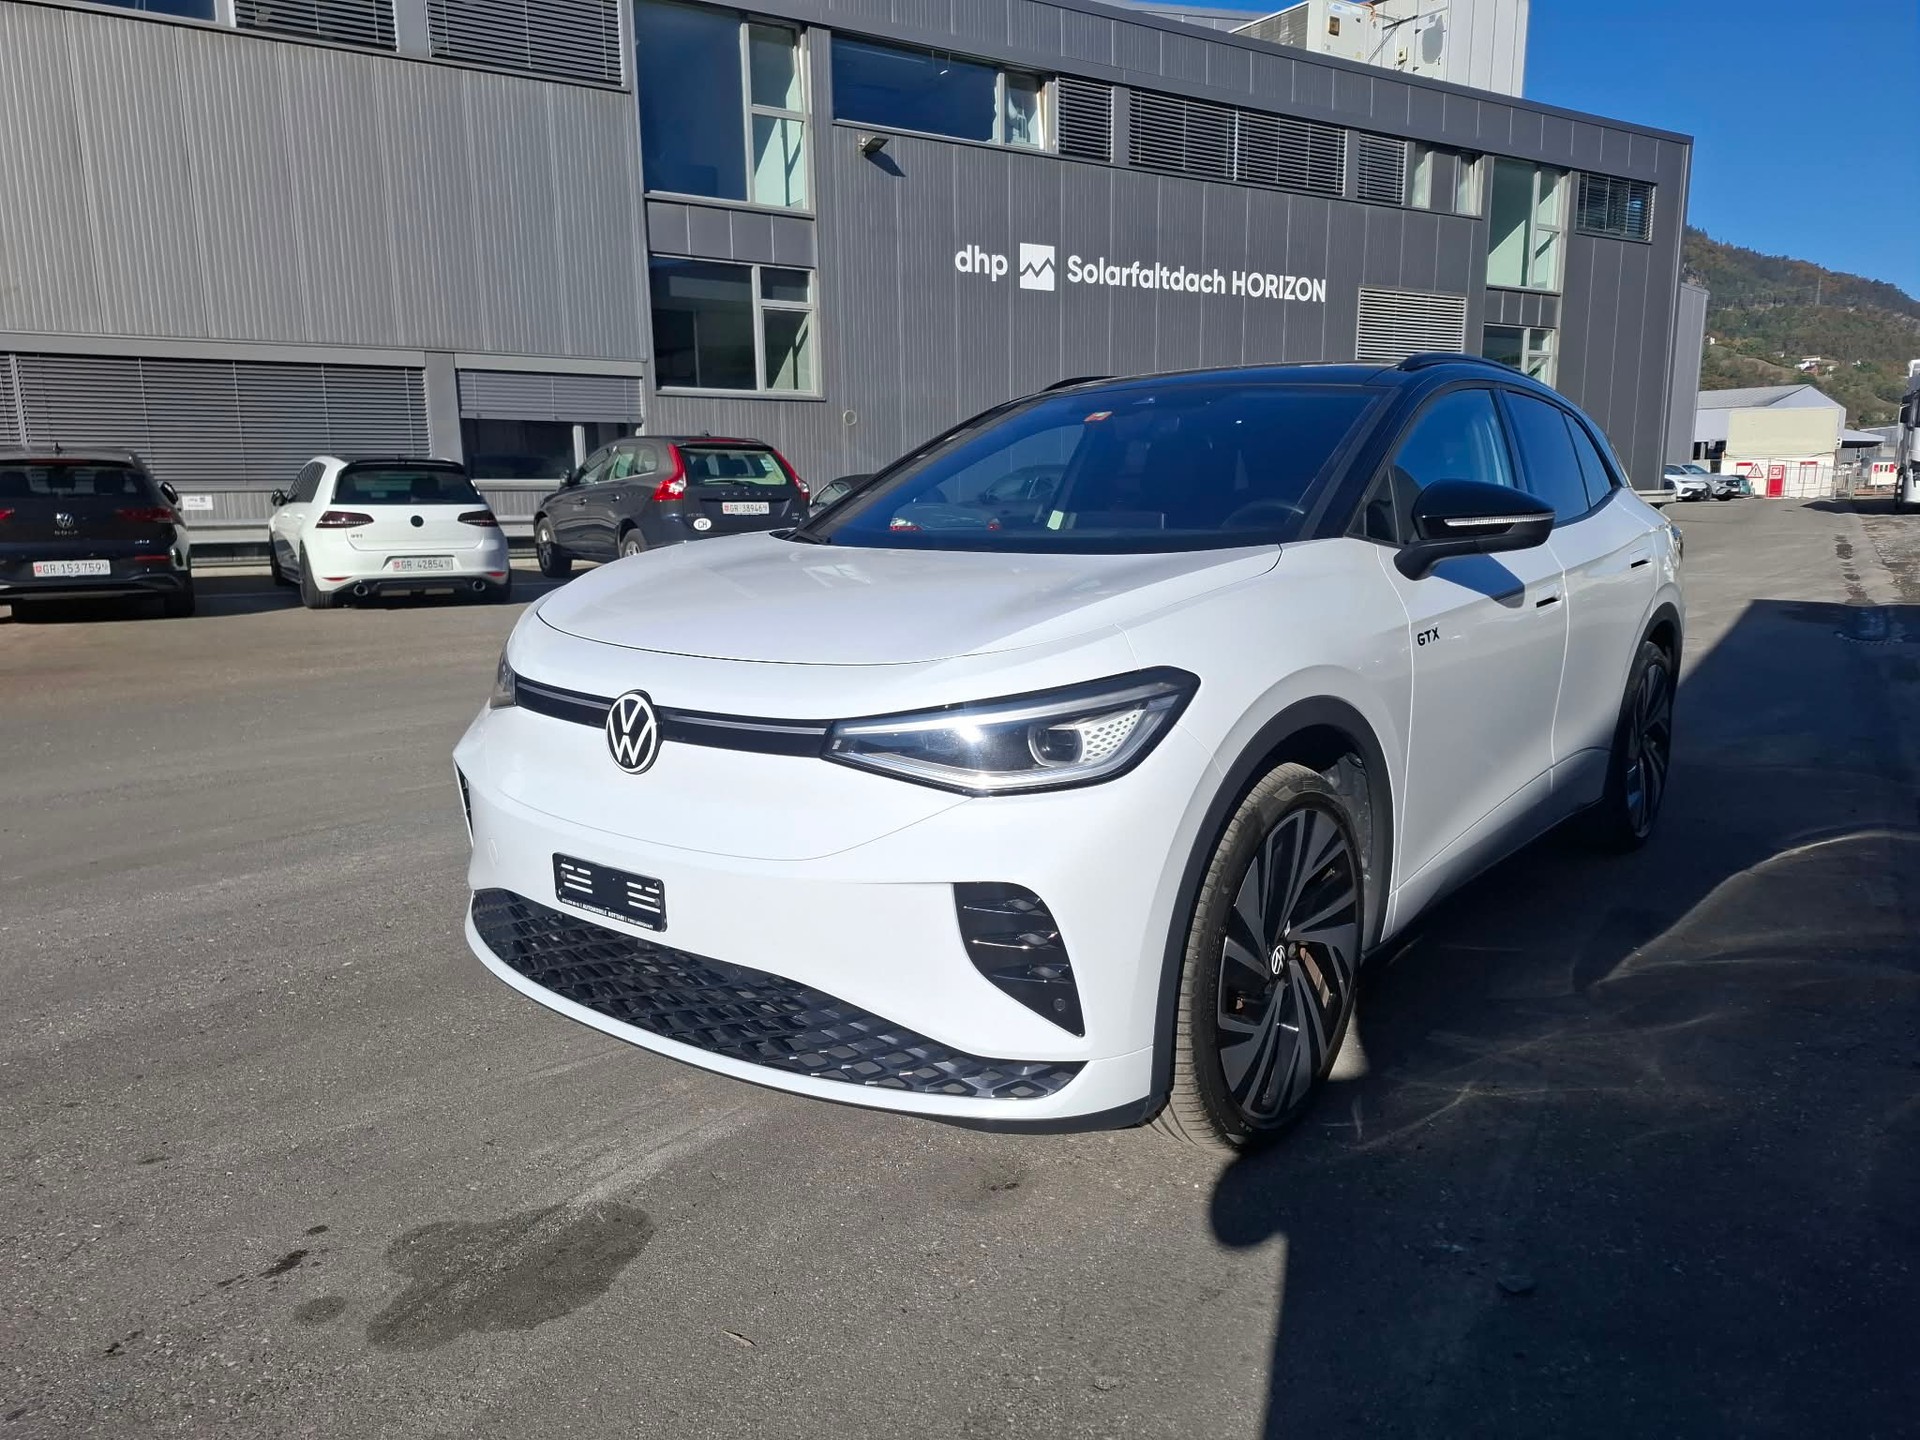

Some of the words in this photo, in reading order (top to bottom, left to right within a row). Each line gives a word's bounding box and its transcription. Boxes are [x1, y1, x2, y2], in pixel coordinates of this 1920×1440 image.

[954, 244, 1009, 282] dhp
[1066, 255, 1226, 295] Solarfaltdach
[1231, 271, 1327, 303] HORIZON
[697, 520, 708, 529] CH
[42, 563, 57, 575] GR
[60, 561, 102, 575] 153759
[401, 560, 413, 570] GR
[417, 559, 444, 570] 42854
[1417, 627, 1440, 647] GTX
